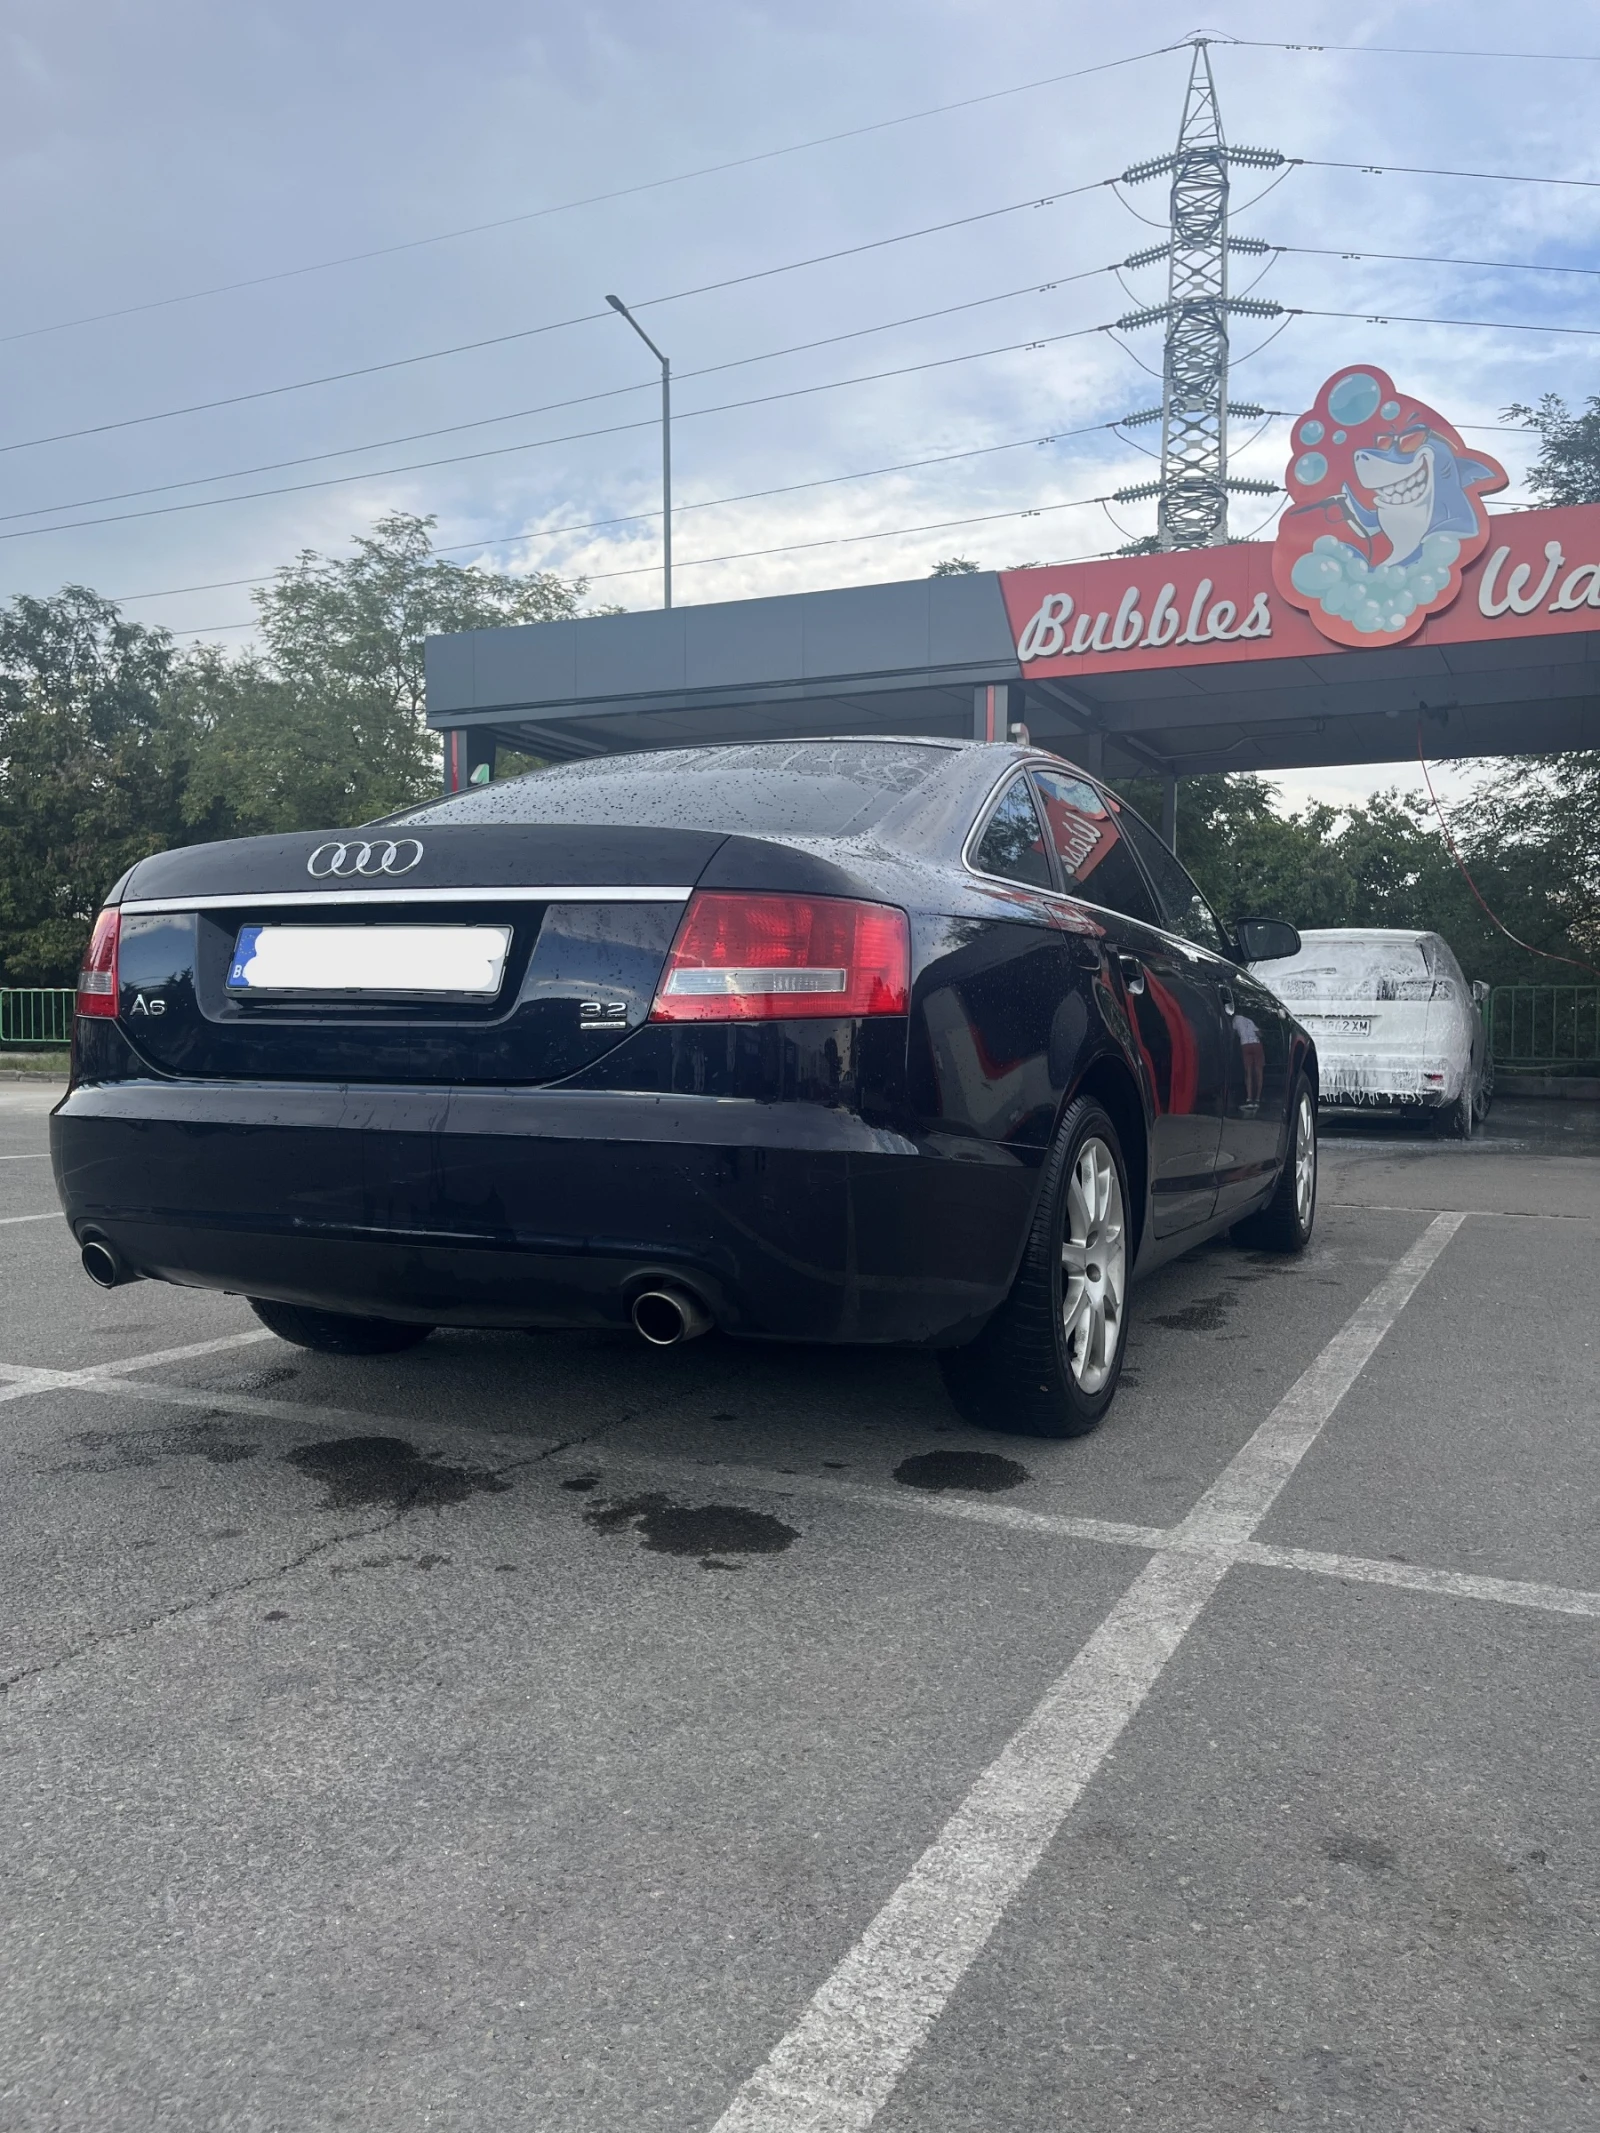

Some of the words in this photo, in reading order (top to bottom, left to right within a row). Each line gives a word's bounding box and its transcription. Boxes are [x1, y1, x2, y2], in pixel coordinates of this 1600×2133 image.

[1017, 578, 1272, 662] Bubbles
[129, 994, 166, 1016] A6
[579, 1002, 627, 1018] 3.2
